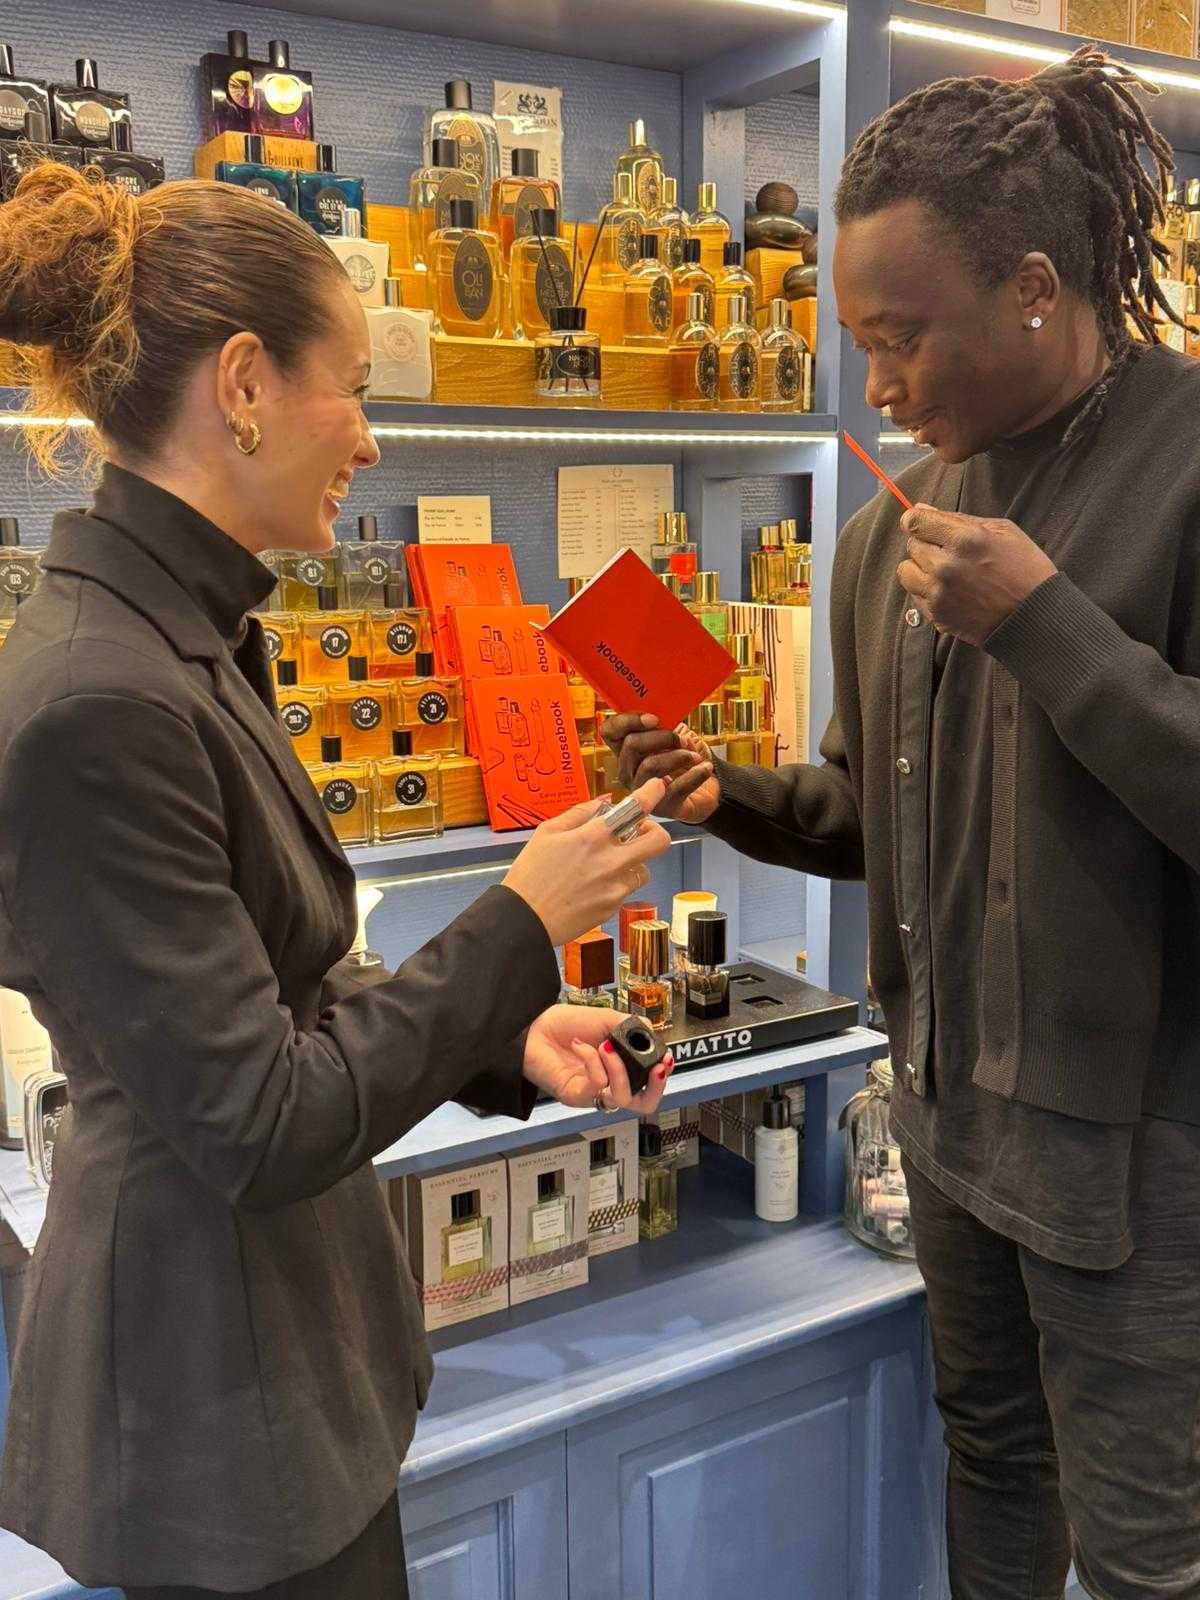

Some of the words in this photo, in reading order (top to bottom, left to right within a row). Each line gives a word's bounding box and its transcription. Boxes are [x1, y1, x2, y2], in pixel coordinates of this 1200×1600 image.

[533, 631, 549, 672] ebook
[597, 640, 649, 699] Nosebook
[361, 708, 371, 719] 22
[550, 700, 573, 771] Nosebook
